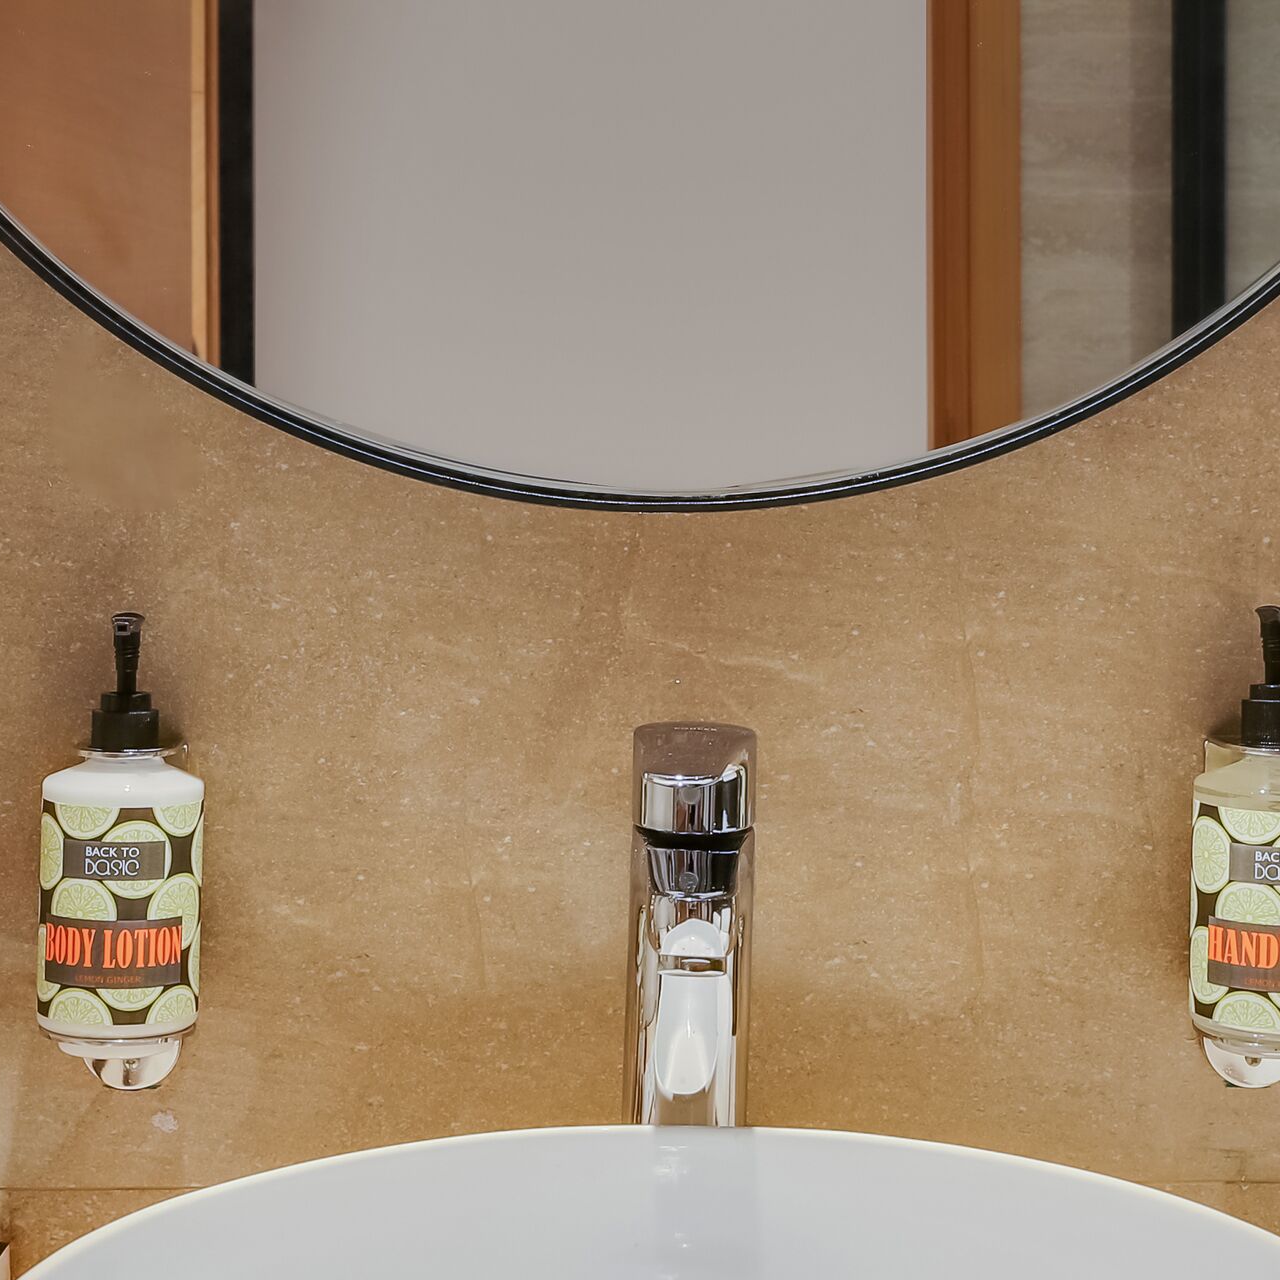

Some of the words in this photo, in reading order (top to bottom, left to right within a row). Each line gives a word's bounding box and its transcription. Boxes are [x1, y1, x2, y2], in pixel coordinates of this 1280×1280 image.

[85, 846, 118, 858] BACK
[121, 847, 140, 858] TO
[45, 922, 96, 968] BODY
[102, 925, 182, 969] LOTION
[106, 976, 144, 984] GINGER
